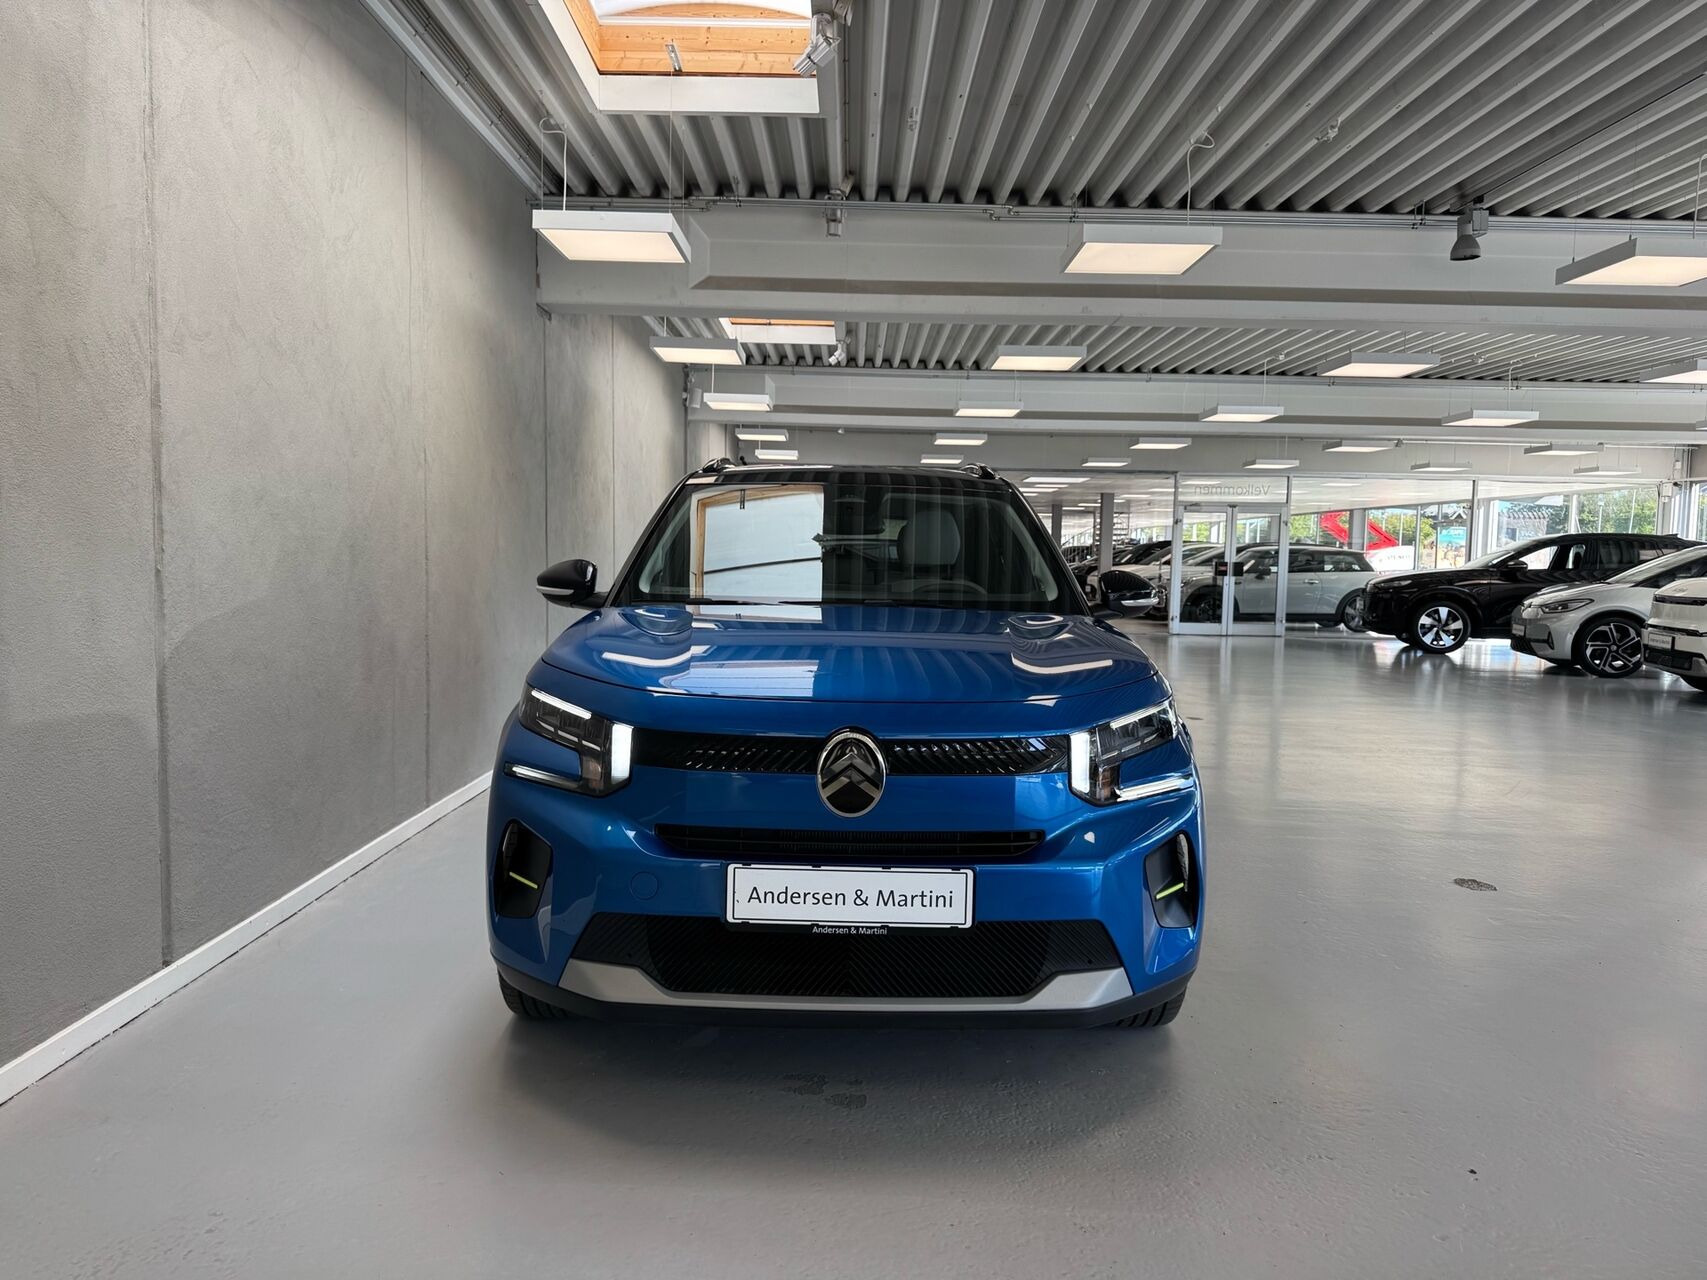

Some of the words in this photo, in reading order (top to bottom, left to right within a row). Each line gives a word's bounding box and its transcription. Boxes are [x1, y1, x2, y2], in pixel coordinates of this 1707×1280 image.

[747, 886, 846, 906] Andersen
[853, 888, 869, 907] &
[876, 889, 953, 908] Martini
[812, 926, 849, 934] Andersen
[850, 927, 857, 935] &
[858, 927, 888, 935] Martini
